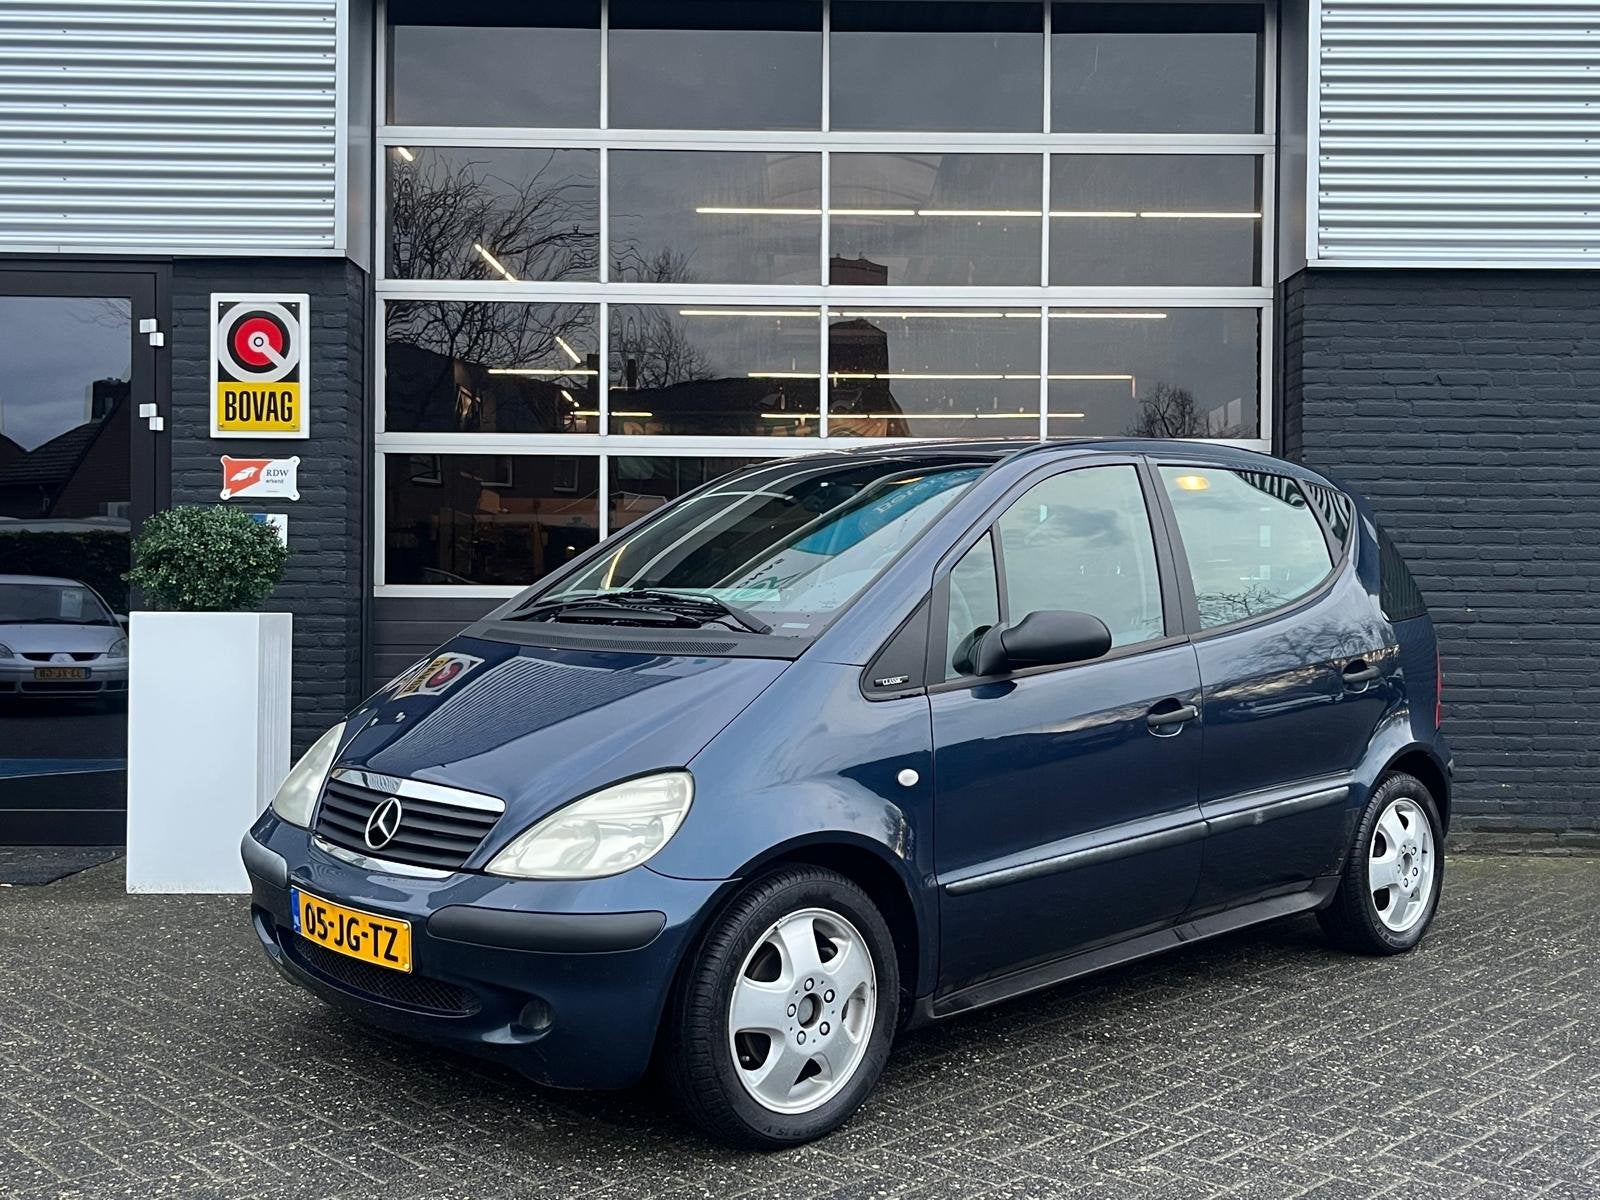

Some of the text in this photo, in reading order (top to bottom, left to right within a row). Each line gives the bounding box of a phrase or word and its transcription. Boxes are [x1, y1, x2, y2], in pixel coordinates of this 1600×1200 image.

[225, 391, 293, 422] BOVAG
[266, 469, 289, 477] RDW
[305, 902, 399, 962] 05-JG-TZ
